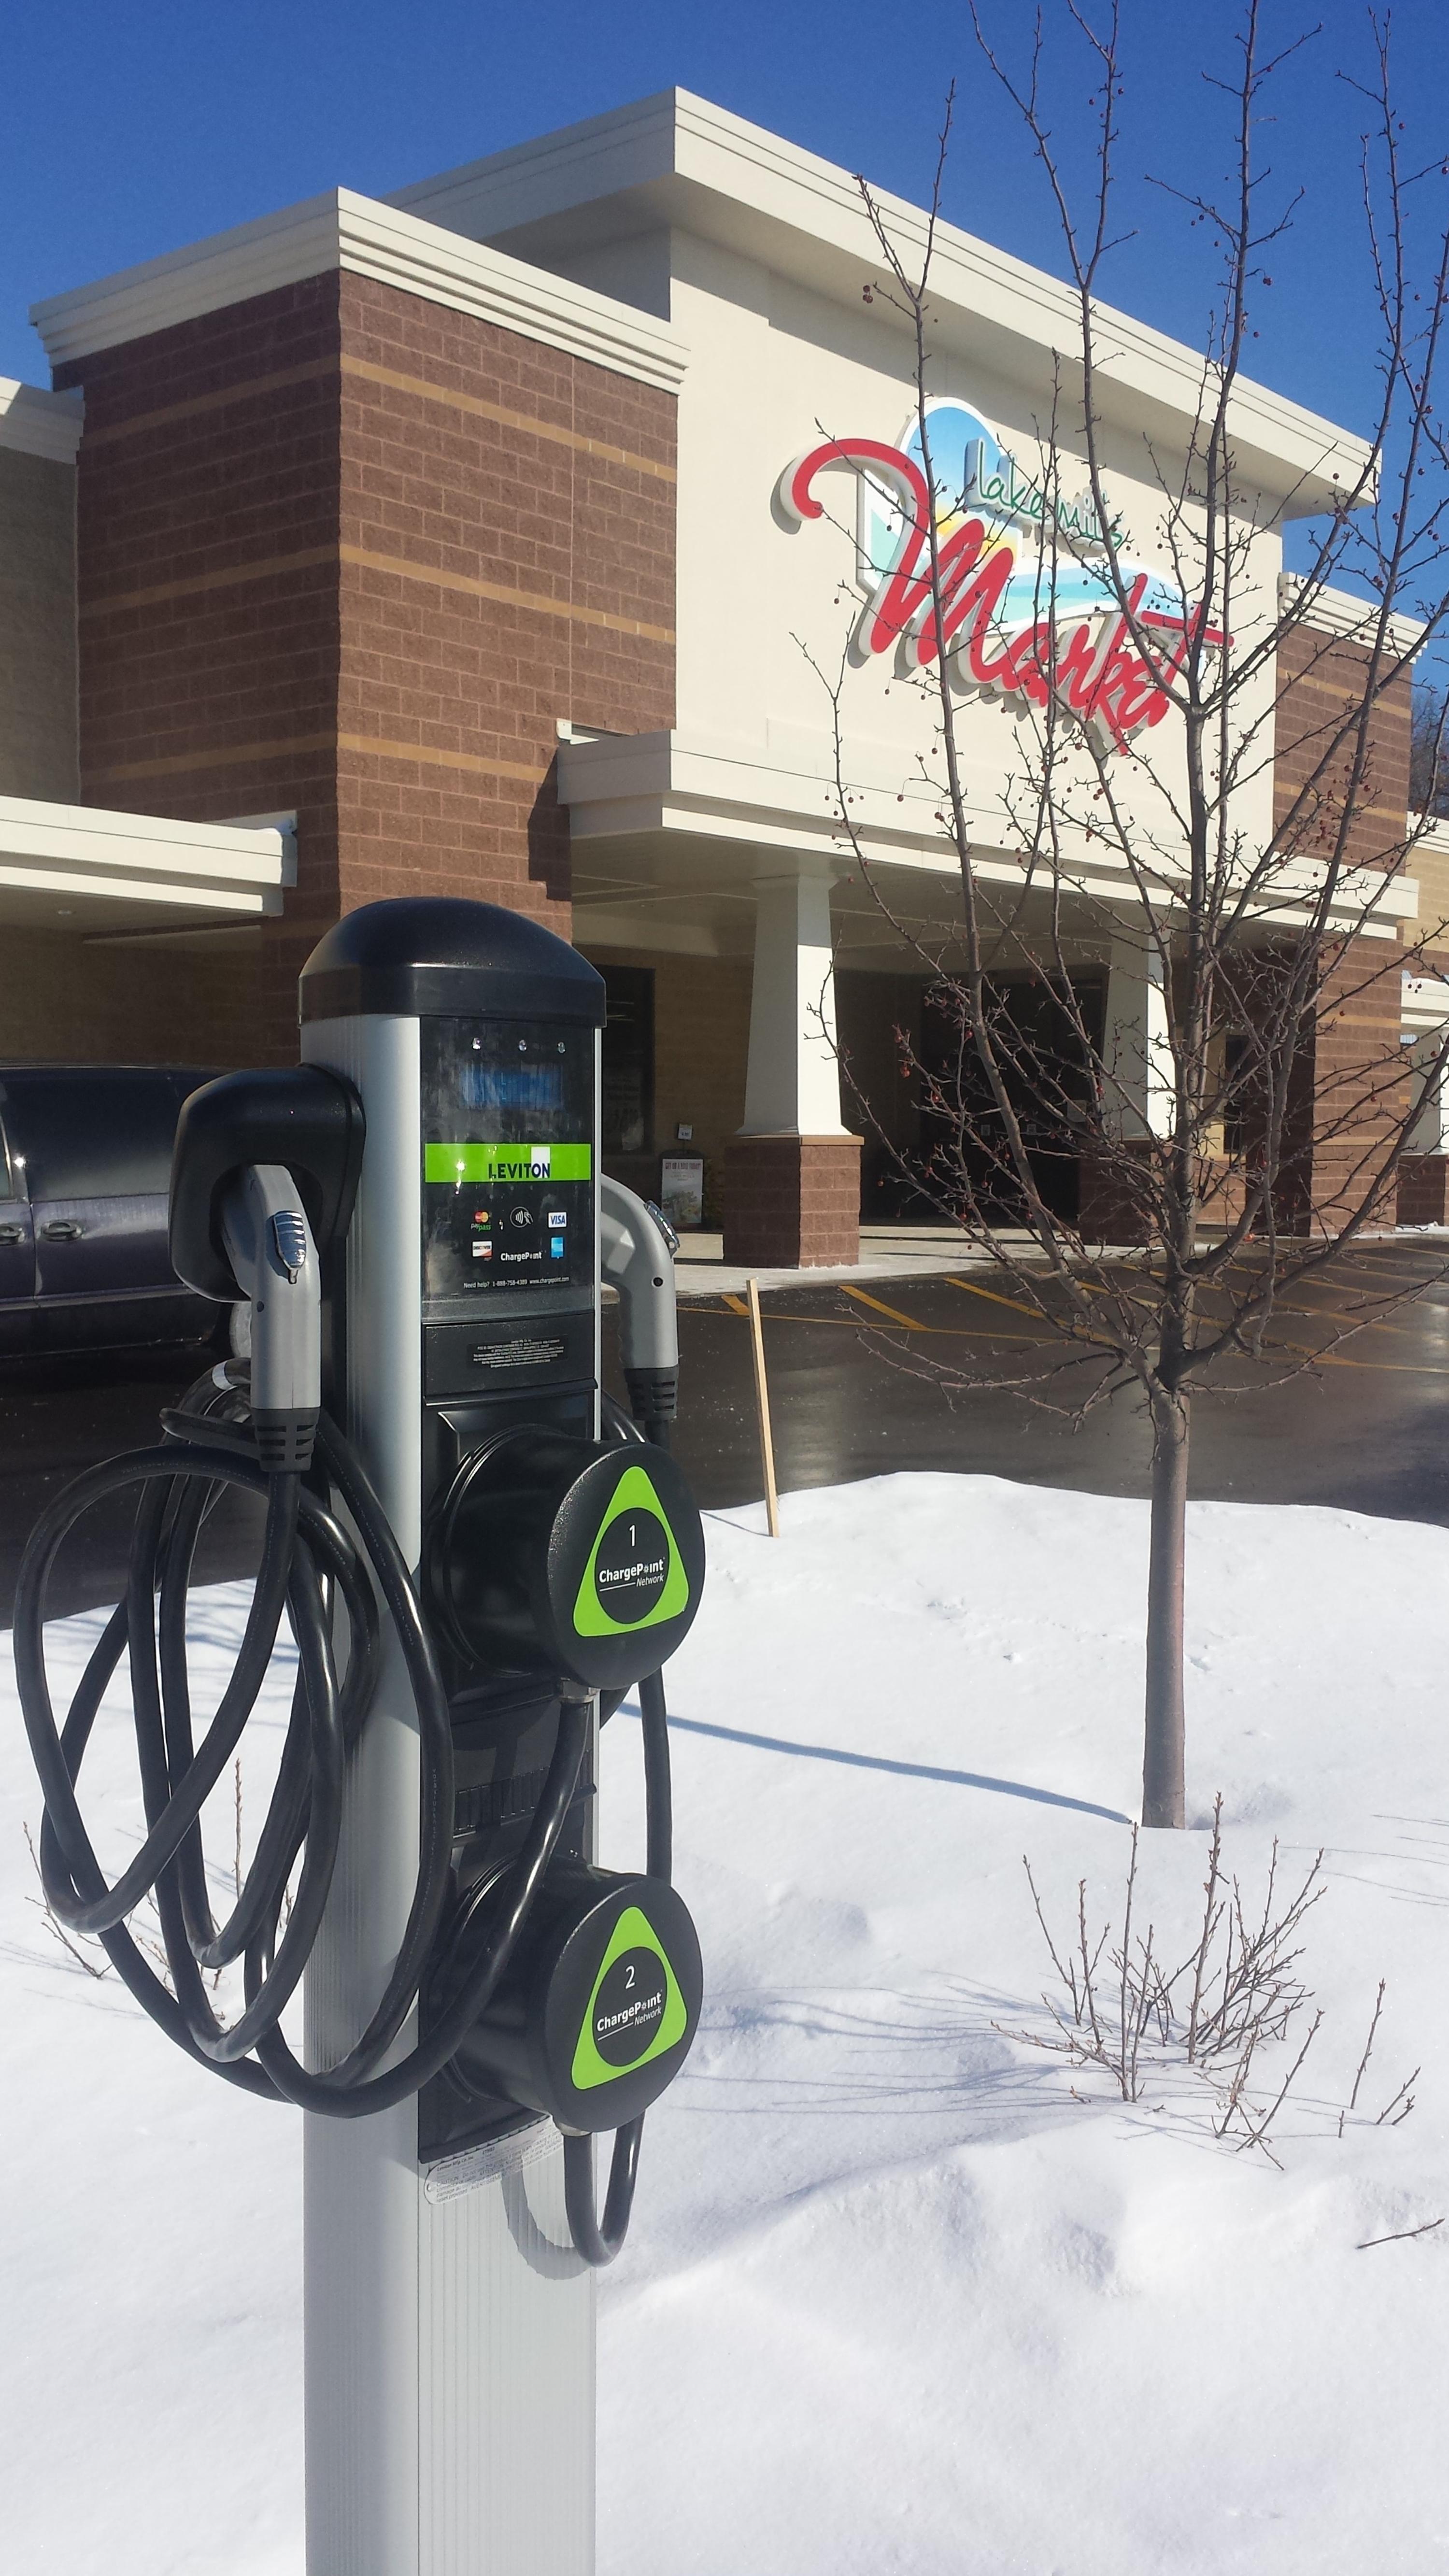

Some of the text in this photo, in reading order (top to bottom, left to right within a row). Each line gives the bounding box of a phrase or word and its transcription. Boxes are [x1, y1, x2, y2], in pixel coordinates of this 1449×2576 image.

[488, 1162, 551, 1179] LEVITON
[550, 1215, 566, 1225] VISA
[500, 1251, 542, 1262] ChargePoint
[629, 1524, 636, 1547] 1
[598, 1558, 664, 1583] ChargePoint
[636, 1574, 664, 1587] Network
[625, 1965, 636, 1989] 2
[597, 1992, 661, 2032] ChargePoint
[634, 2006, 661, 2026] Network
